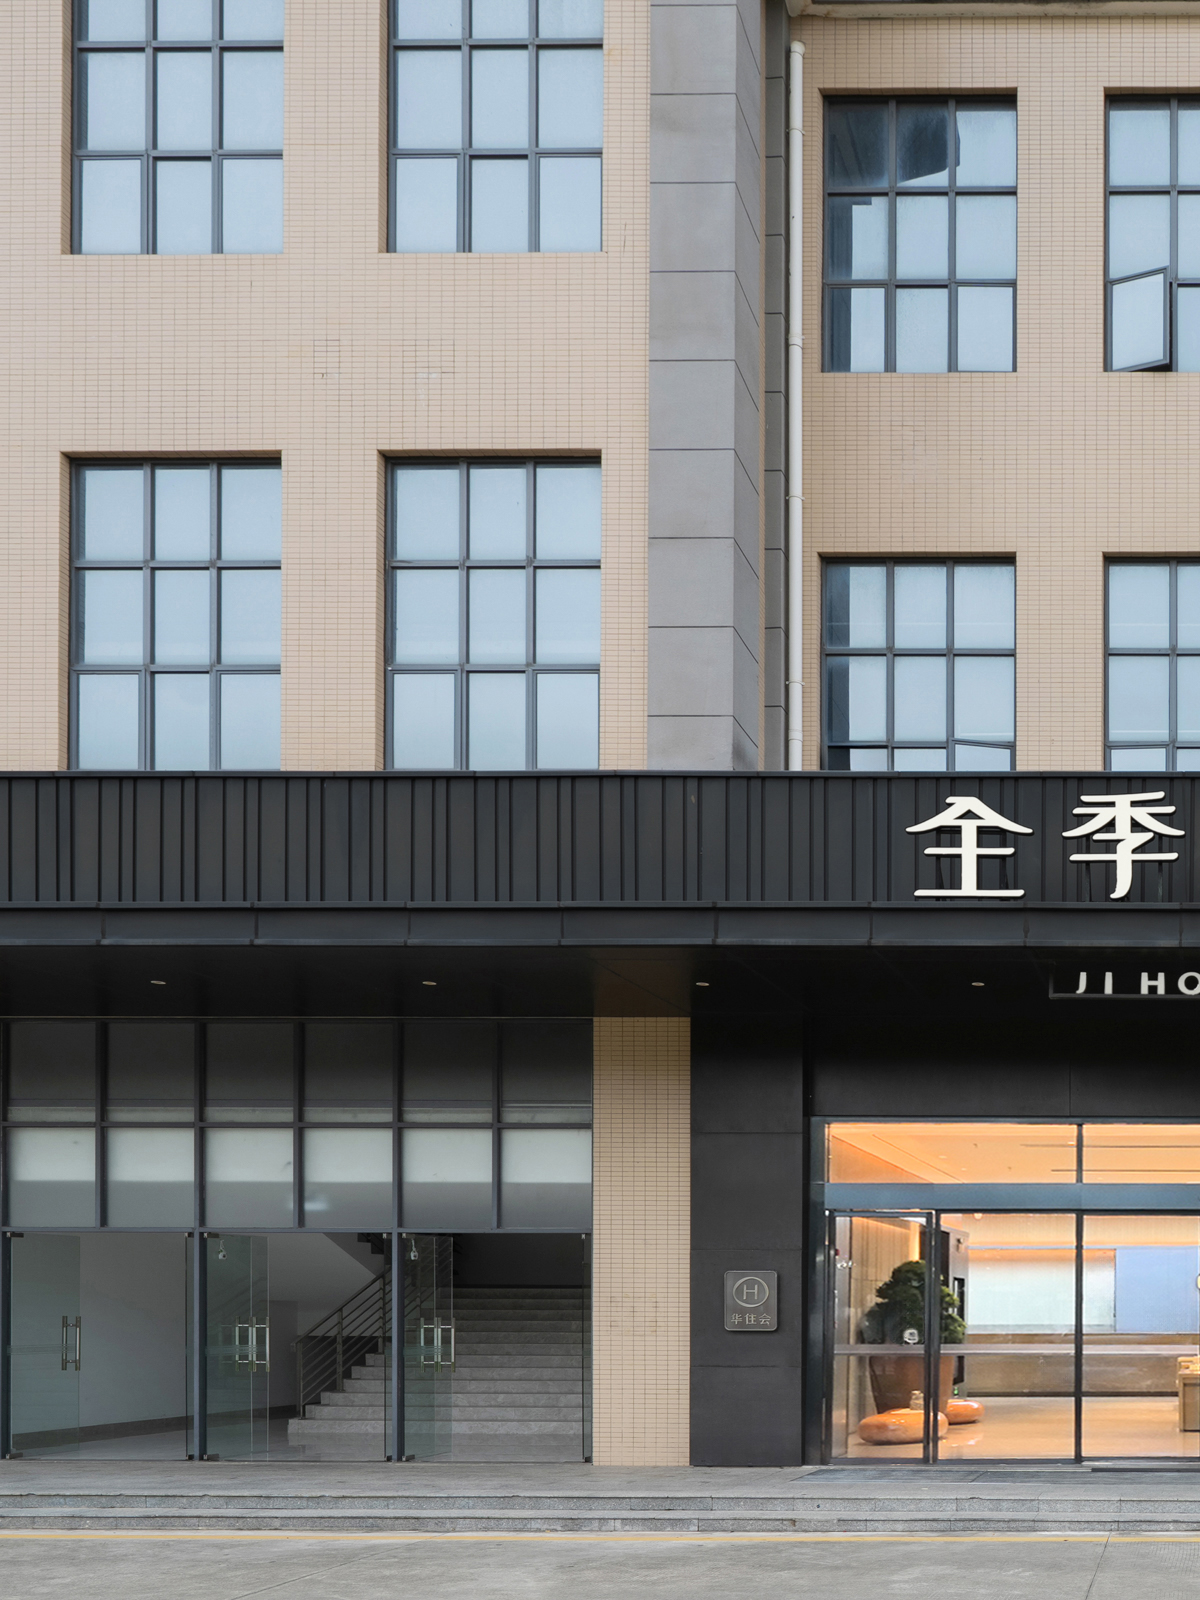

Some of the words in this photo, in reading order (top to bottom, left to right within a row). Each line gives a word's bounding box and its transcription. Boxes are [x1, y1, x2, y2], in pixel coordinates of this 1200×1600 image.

[1076, 971, 1113, 995] JI
[730, 1313, 772, 1326] 华住会
